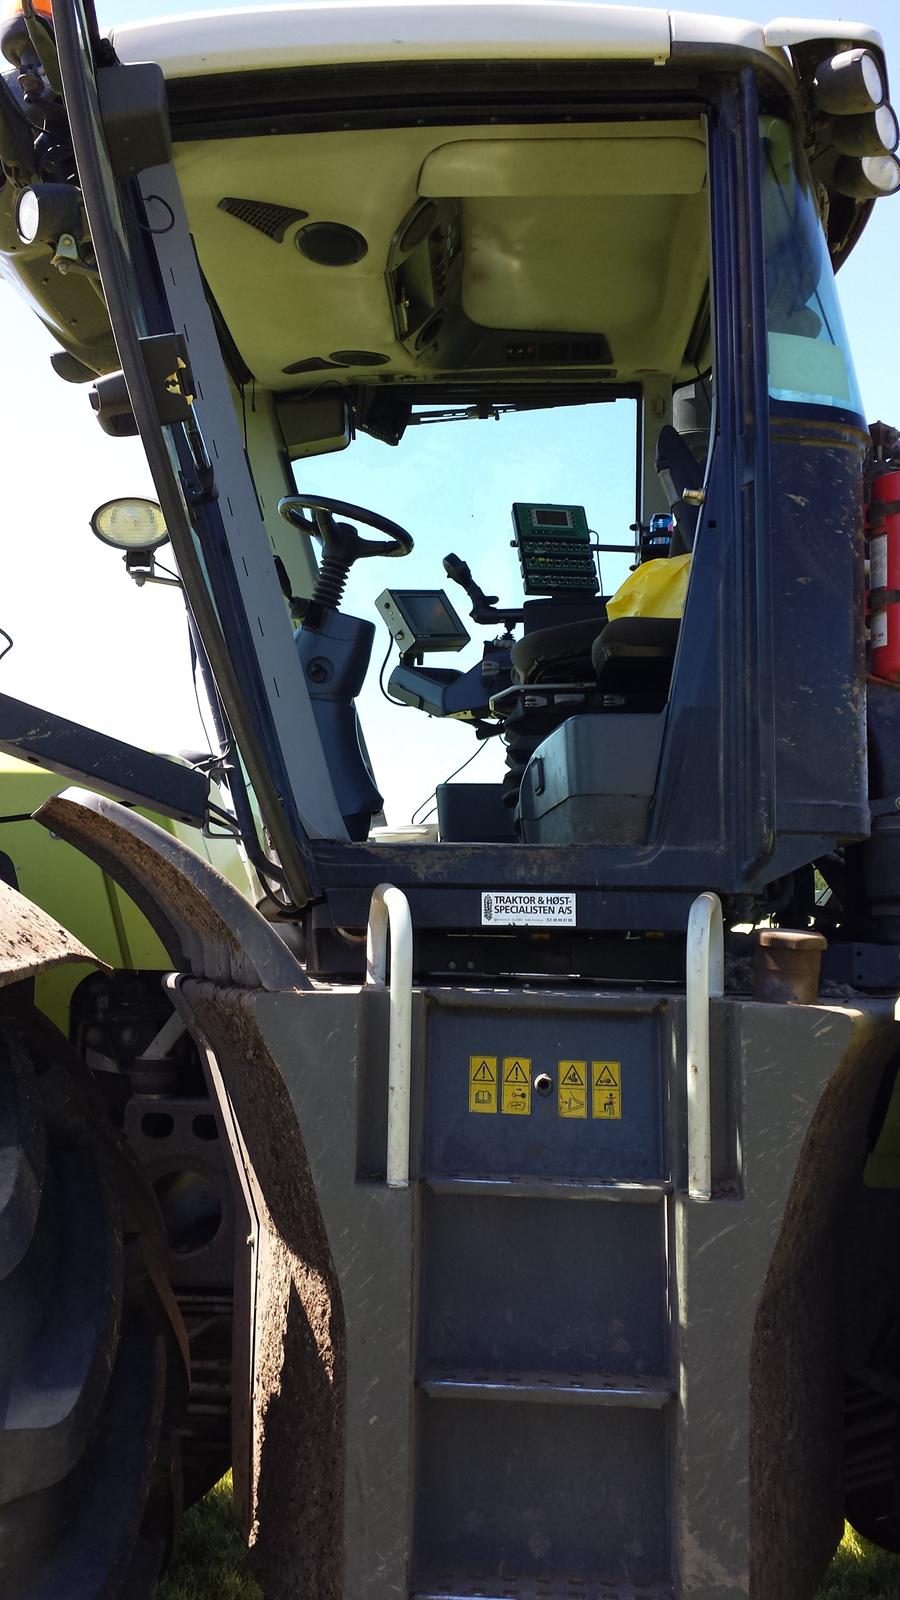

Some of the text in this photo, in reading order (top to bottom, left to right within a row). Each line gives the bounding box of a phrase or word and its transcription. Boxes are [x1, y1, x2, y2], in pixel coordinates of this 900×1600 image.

[494, 896, 572, 905] TRAKTOR & HØST-
[494, 905, 573, 915] SPECIALISTEN A/S
